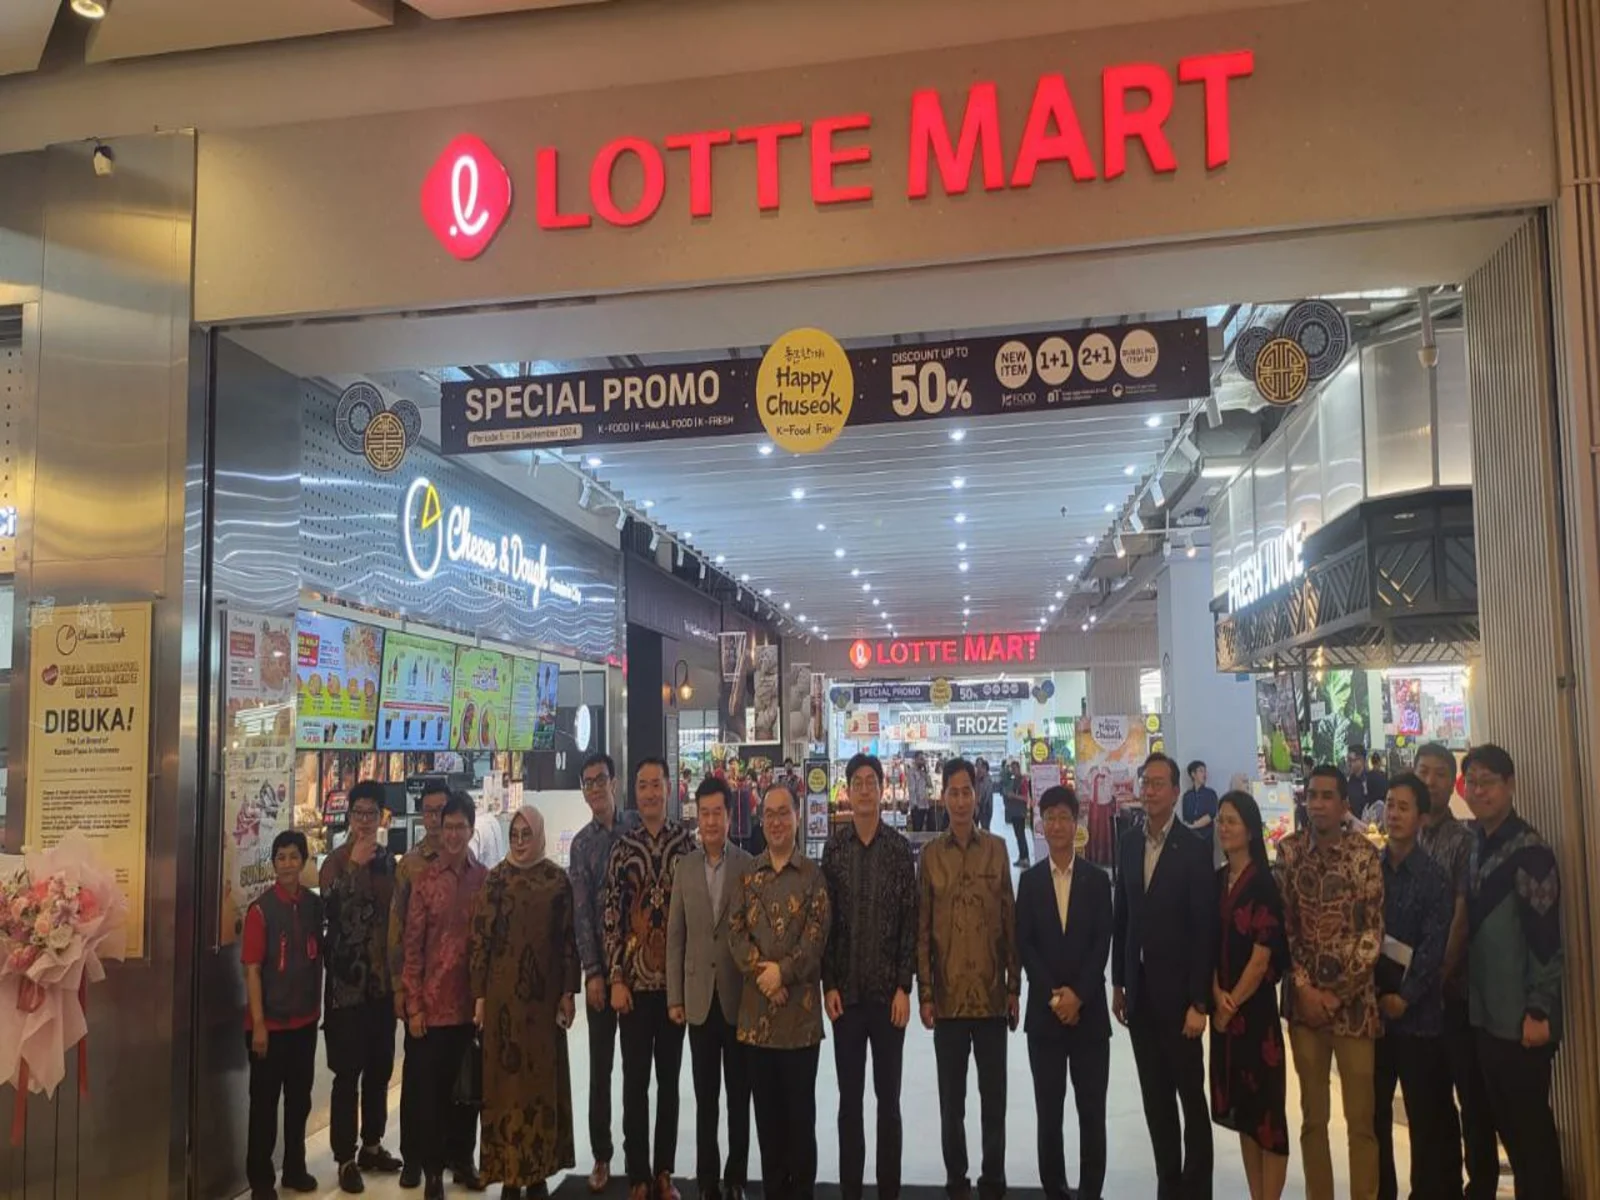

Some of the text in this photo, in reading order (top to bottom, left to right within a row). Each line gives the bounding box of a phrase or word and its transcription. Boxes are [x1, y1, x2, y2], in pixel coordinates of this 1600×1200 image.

[535, 114, 873, 229] LOTTE
[907, 50, 1254, 200] MART
[892, 346, 969, 364] DISCOUNT UP TO
[1001, 351, 1026, 363] NEW
[1040, 350, 1069, 370] 1+1
[1082, 346, 1112, 366] 2+1
[1000, 364, 1027, 376] ITEM
[776, 366, 833, 397] Happy
[891, 361, 972, 416] 50%
[465, 369, 721, 422] SPECIAL PROMO
[766, 392, 843, 416] Chuseok
[671, 418, 693, 429] FOOD
[776, 423, 834, 435] K-Food Fair
[522, 428, 559, 440] September
[446, 505, 498, 570] Cheese
[499, 535, 509, 576] &
[510, 534, 548, 609] Dough
[1228, 520, 1305, 614] FRESH JUICE
[877, 640, 957, 664] LOTTE
[964, 632, 1041, 662] MART
[859, 687, 891, 698] SPECIAL
[892, 686, 921, 697] PROMO
[45, 706, 134, 733] DIBUKA!
[900, 714, 929, 725] RODUK
